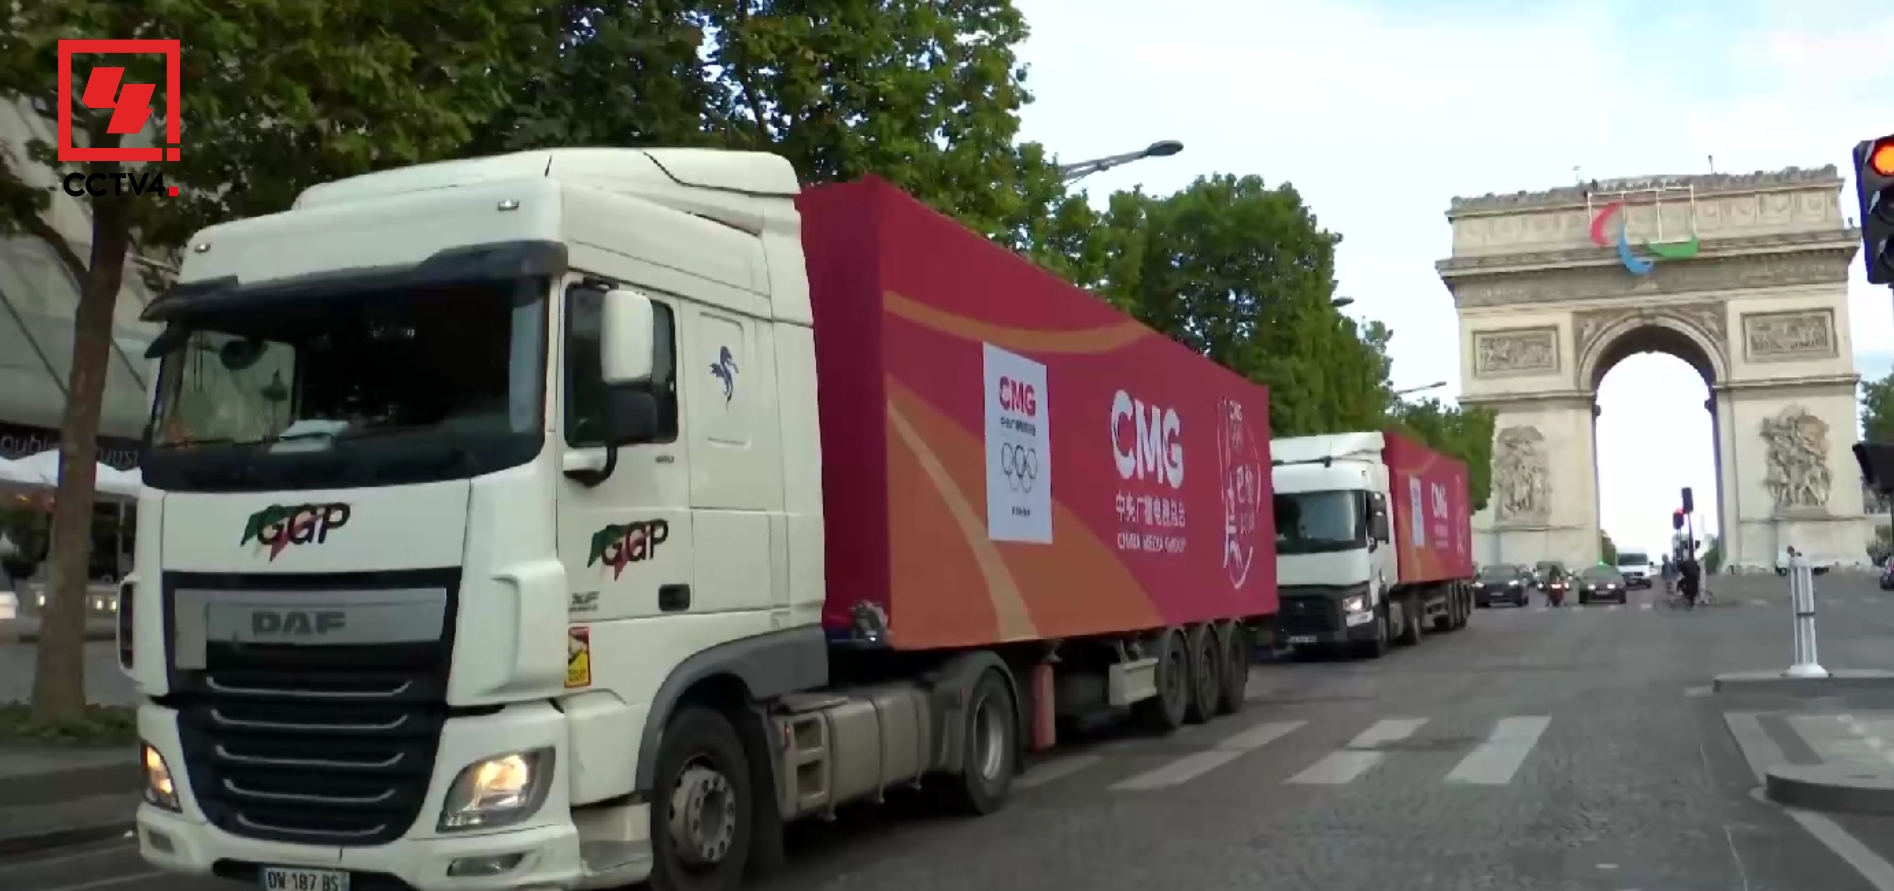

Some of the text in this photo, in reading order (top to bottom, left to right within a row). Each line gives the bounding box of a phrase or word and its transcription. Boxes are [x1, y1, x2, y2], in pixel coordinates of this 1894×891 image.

[999, 376, 1036, 416] CMG
[1111, 389, 1184, 488] CMG
[256, 502, 351, 546] GGP
[1116, 489, 1186, 528] 中央广播电视总台
[601, 518, 669, 566] GGP
[1117, 531, 1187, 553] CHINA MEDIA GROUP
[252, 611, 346, 636] DAF
